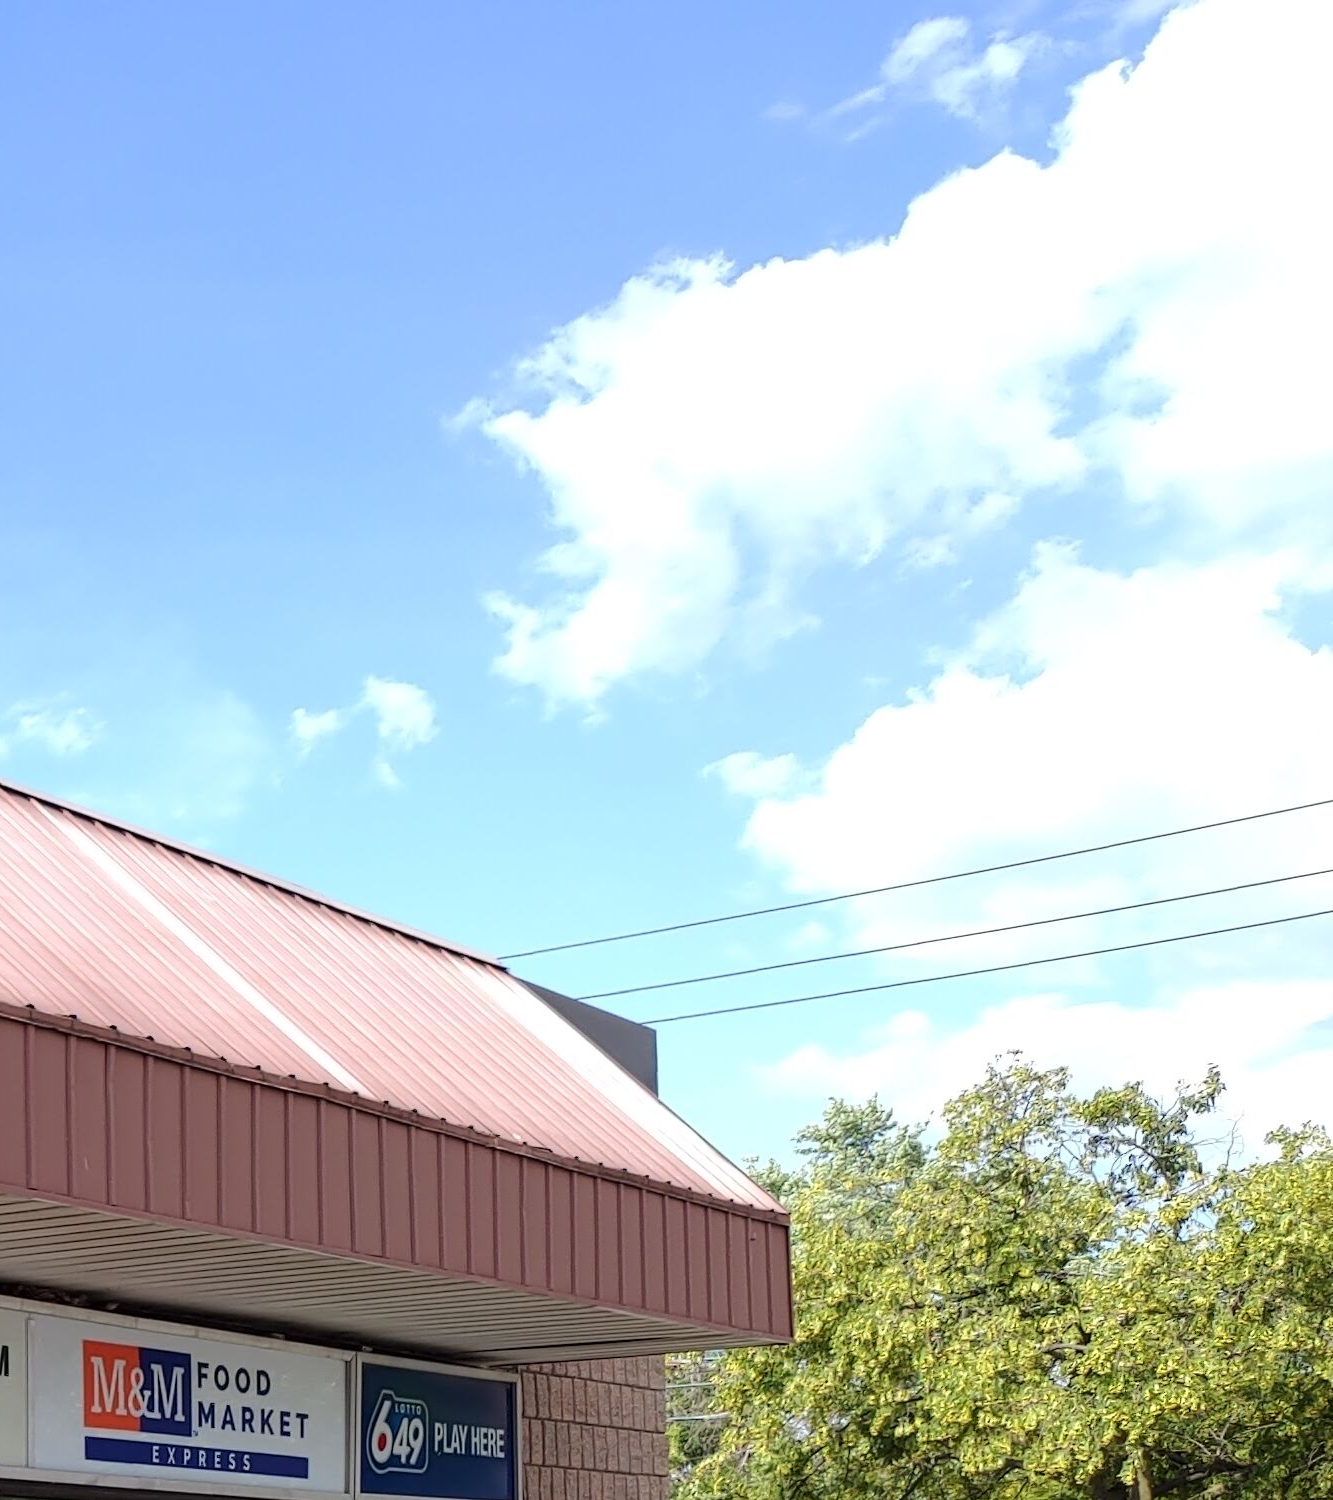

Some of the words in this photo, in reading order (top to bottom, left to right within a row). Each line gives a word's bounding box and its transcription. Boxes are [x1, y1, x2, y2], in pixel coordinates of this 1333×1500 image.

[90, 1356, 185, 1422] M&M
[197, 1361, 271, 1396] FOOD
[198, 1401, 309, 1439] MARKET
[395, 1403, 422, 1416] LOTTO
[371, 1400, 424, 1466] 649
[434, 1422, 468, 1455] PLAY
[471, 1426, 505, 1458] HERE
[152, 1445, 251, 1471] EXPRESS
